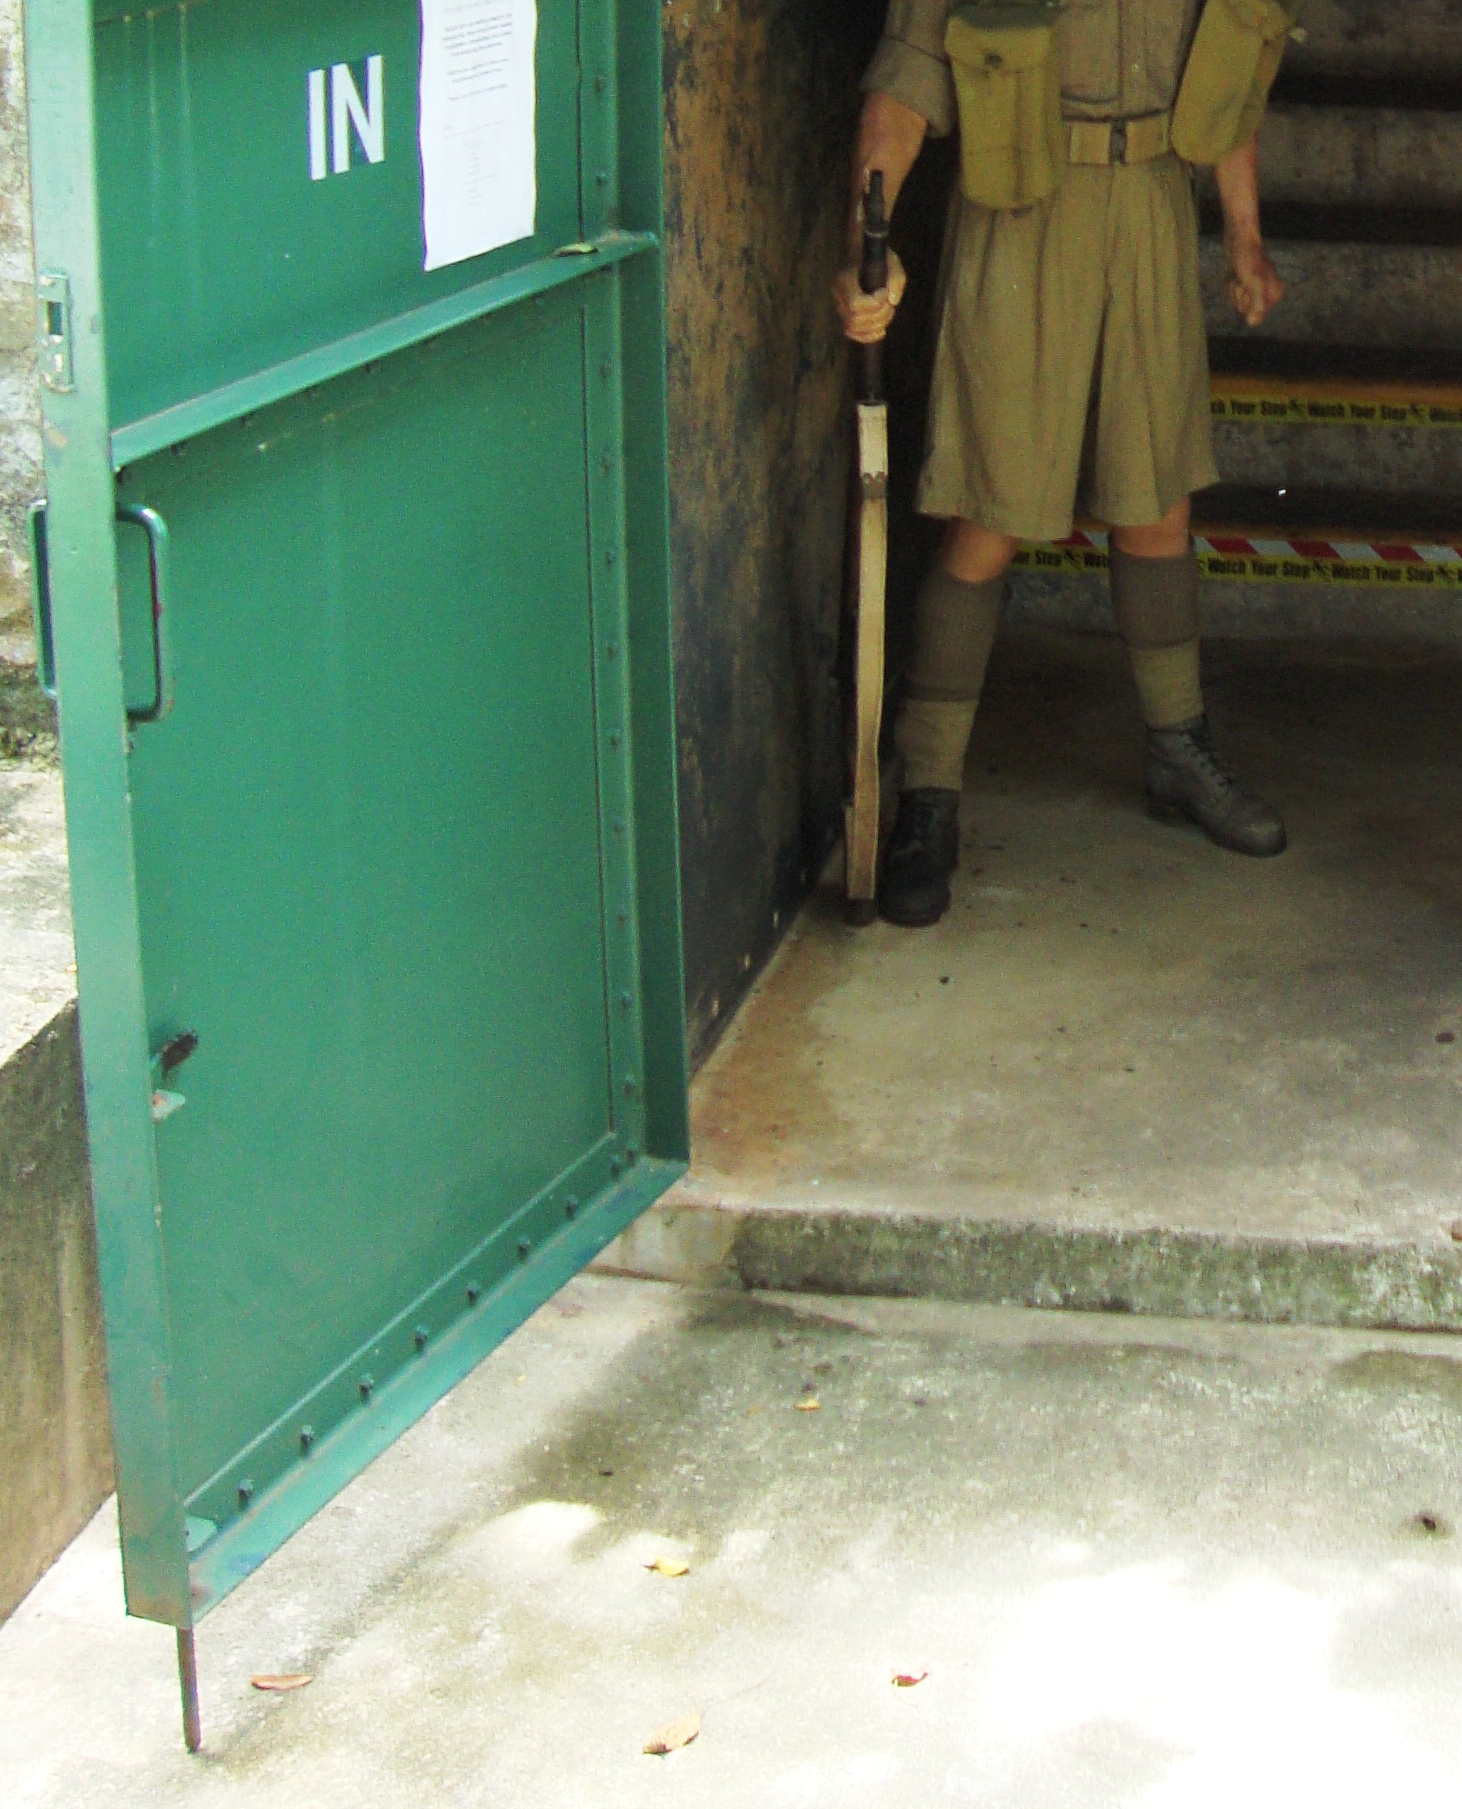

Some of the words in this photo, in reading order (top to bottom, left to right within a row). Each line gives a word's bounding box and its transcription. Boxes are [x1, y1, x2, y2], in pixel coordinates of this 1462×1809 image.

[307, 54, 386, 181] IN
[1230, 400, 1257, 416] Your
[1261, 401, 1288, 417] Step
[1307, 402, 1345, 418] Watch
[1351, 404, 1375, 420] Your
[1380, 405, 1407, 421] Step
[1083, 551, 1110, 569] Wat
[1208, 557, 1245, 575] Watch
[1252, 559, 1278, 576] Your
[1283, 561, 1310, 579] Step
[1332, 563, 1370, 580] Watch
[1376, 565, 1402, 581] Your
[1407, 567, 1434, 583] Step
